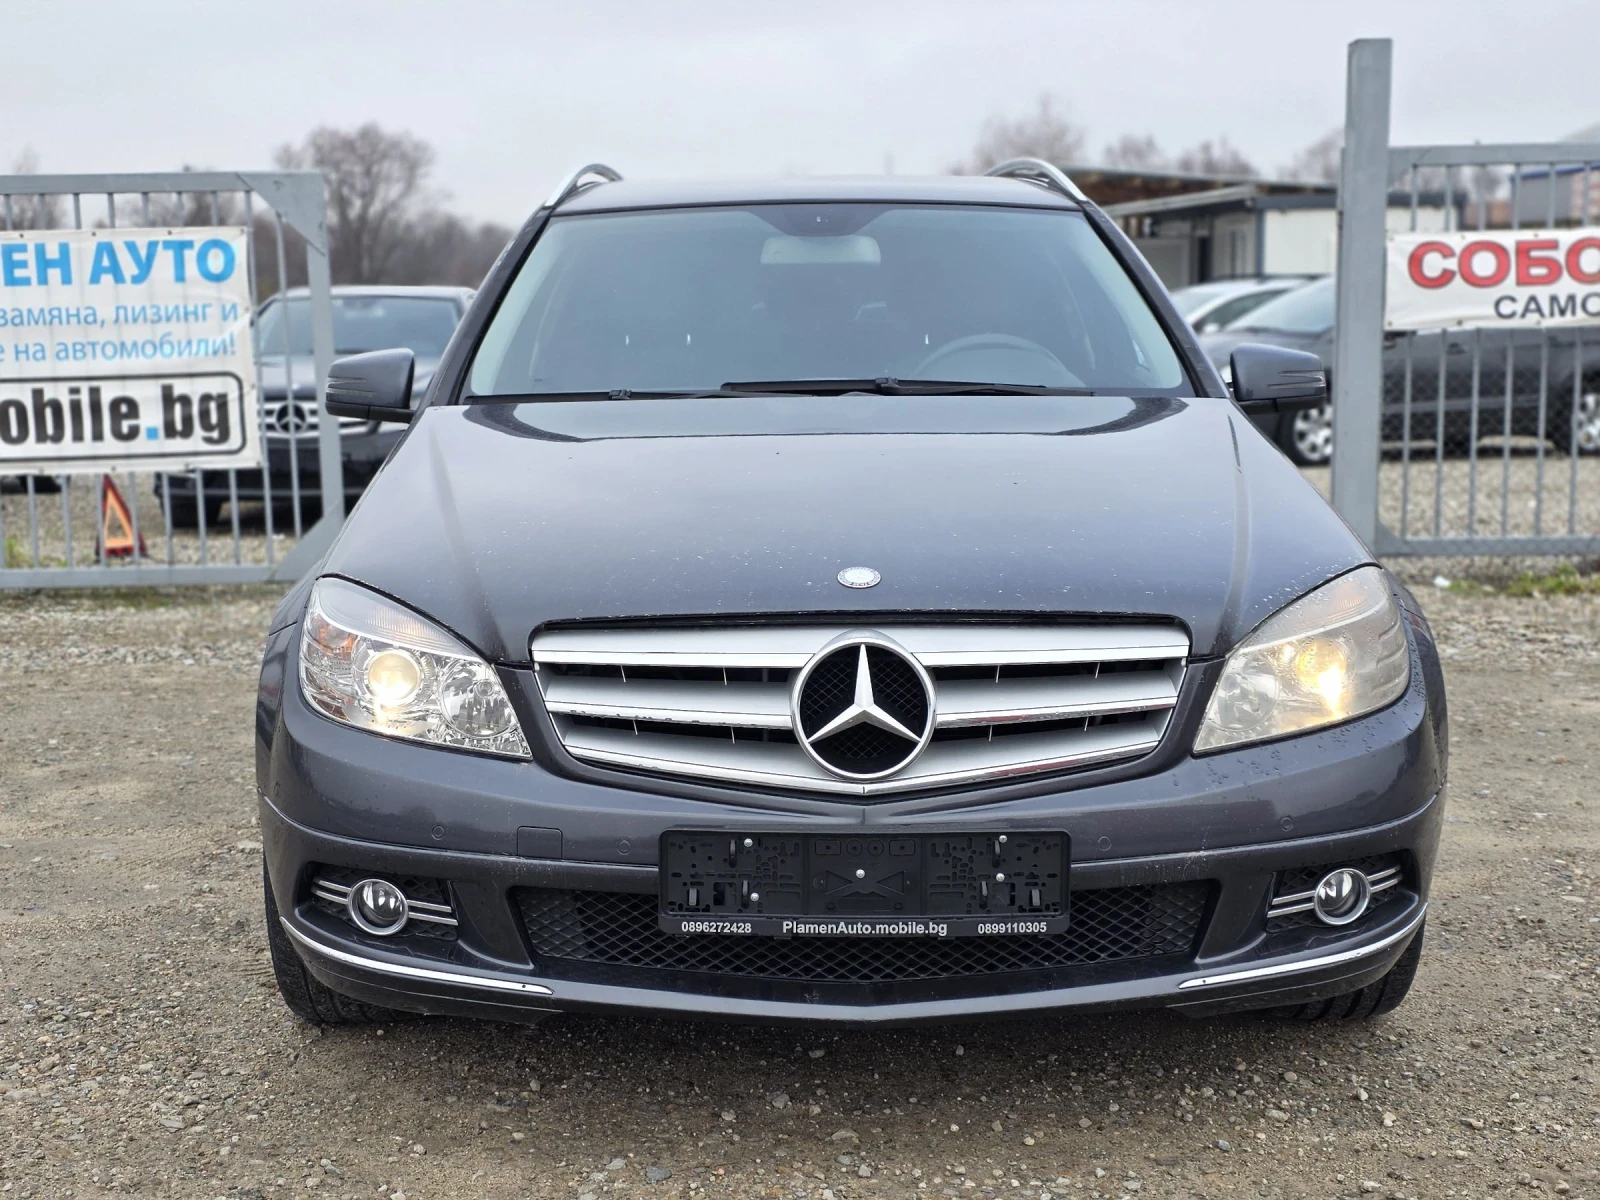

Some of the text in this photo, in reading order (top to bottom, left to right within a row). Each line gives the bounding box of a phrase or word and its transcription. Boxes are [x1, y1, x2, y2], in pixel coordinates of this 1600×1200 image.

[0, 238, 236, 287] ЕН АУТО
[1407, 236, 1600, 290] СОБО
[0, 302, 239, 329] замяна, лизинг и
[14, 342, 46, 362] на
[55, 331, 236, 361] автомобили!
[0, 383, 231, 446] obile.bg
[681, 920, 1047, 937] 0896272428 PlamenAuto.mobile.bg 0899110305
